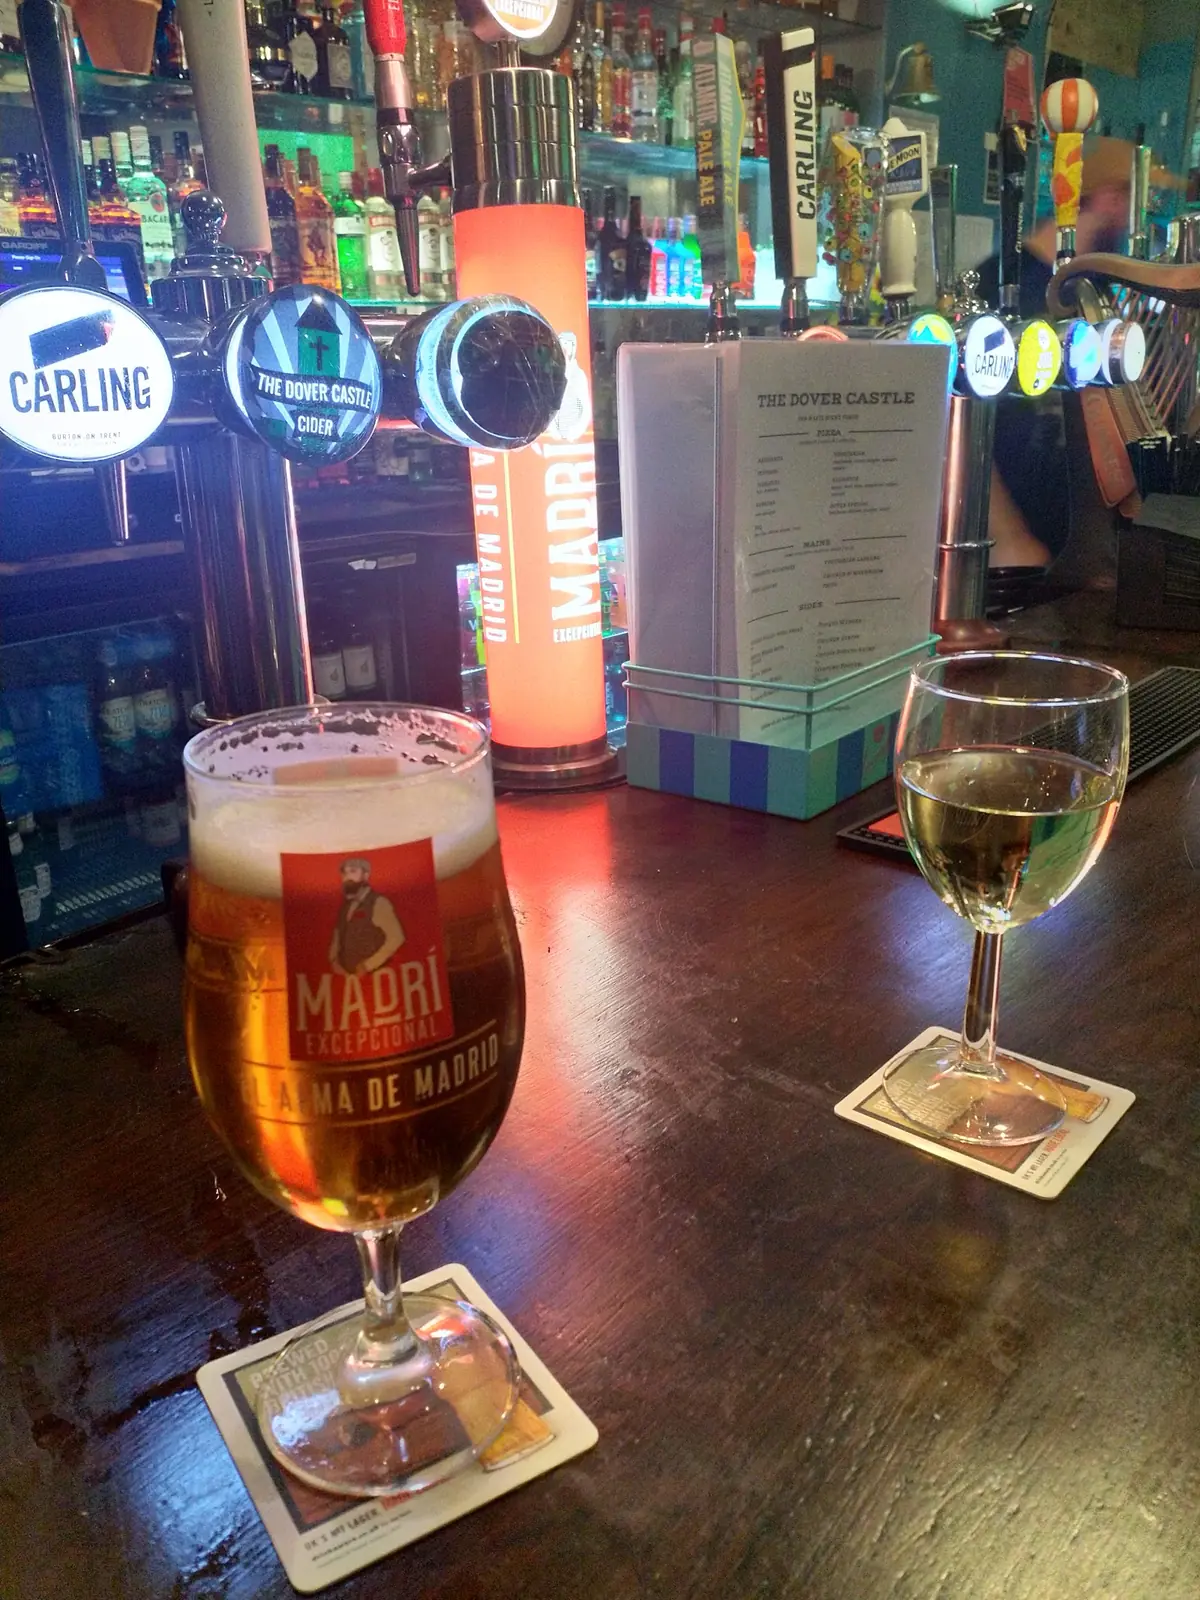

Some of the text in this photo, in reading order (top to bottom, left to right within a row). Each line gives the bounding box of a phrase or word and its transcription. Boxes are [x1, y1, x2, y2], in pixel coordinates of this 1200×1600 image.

[695, 64, 718, 207] ATLANTIC PALE ALE
[793, 89, 816, 220] CARLING
[896, 147, 920, 163] MOON
[9, 366, 150, 413] CARLING
[258, 372, 373, 409] THE DOVER CASTLE
[757, 390, 915, 408] THE DOVER CASTLE
[297, 415, 333, 436] CIDER
[474, 484, 499, 518] DE
[803, 539, 831, 548] MAINS
[478, 532, 507, 644] MADRID
[799, 601, 823, 611] SIDES
[296, 947, 443, 1032] MADRÍ
[306, 1018, 437, 1056] EXCEPCIONAL
[367, 1073, 401, 1112] DE
[414, 1032, 500, 1101] MADRID
